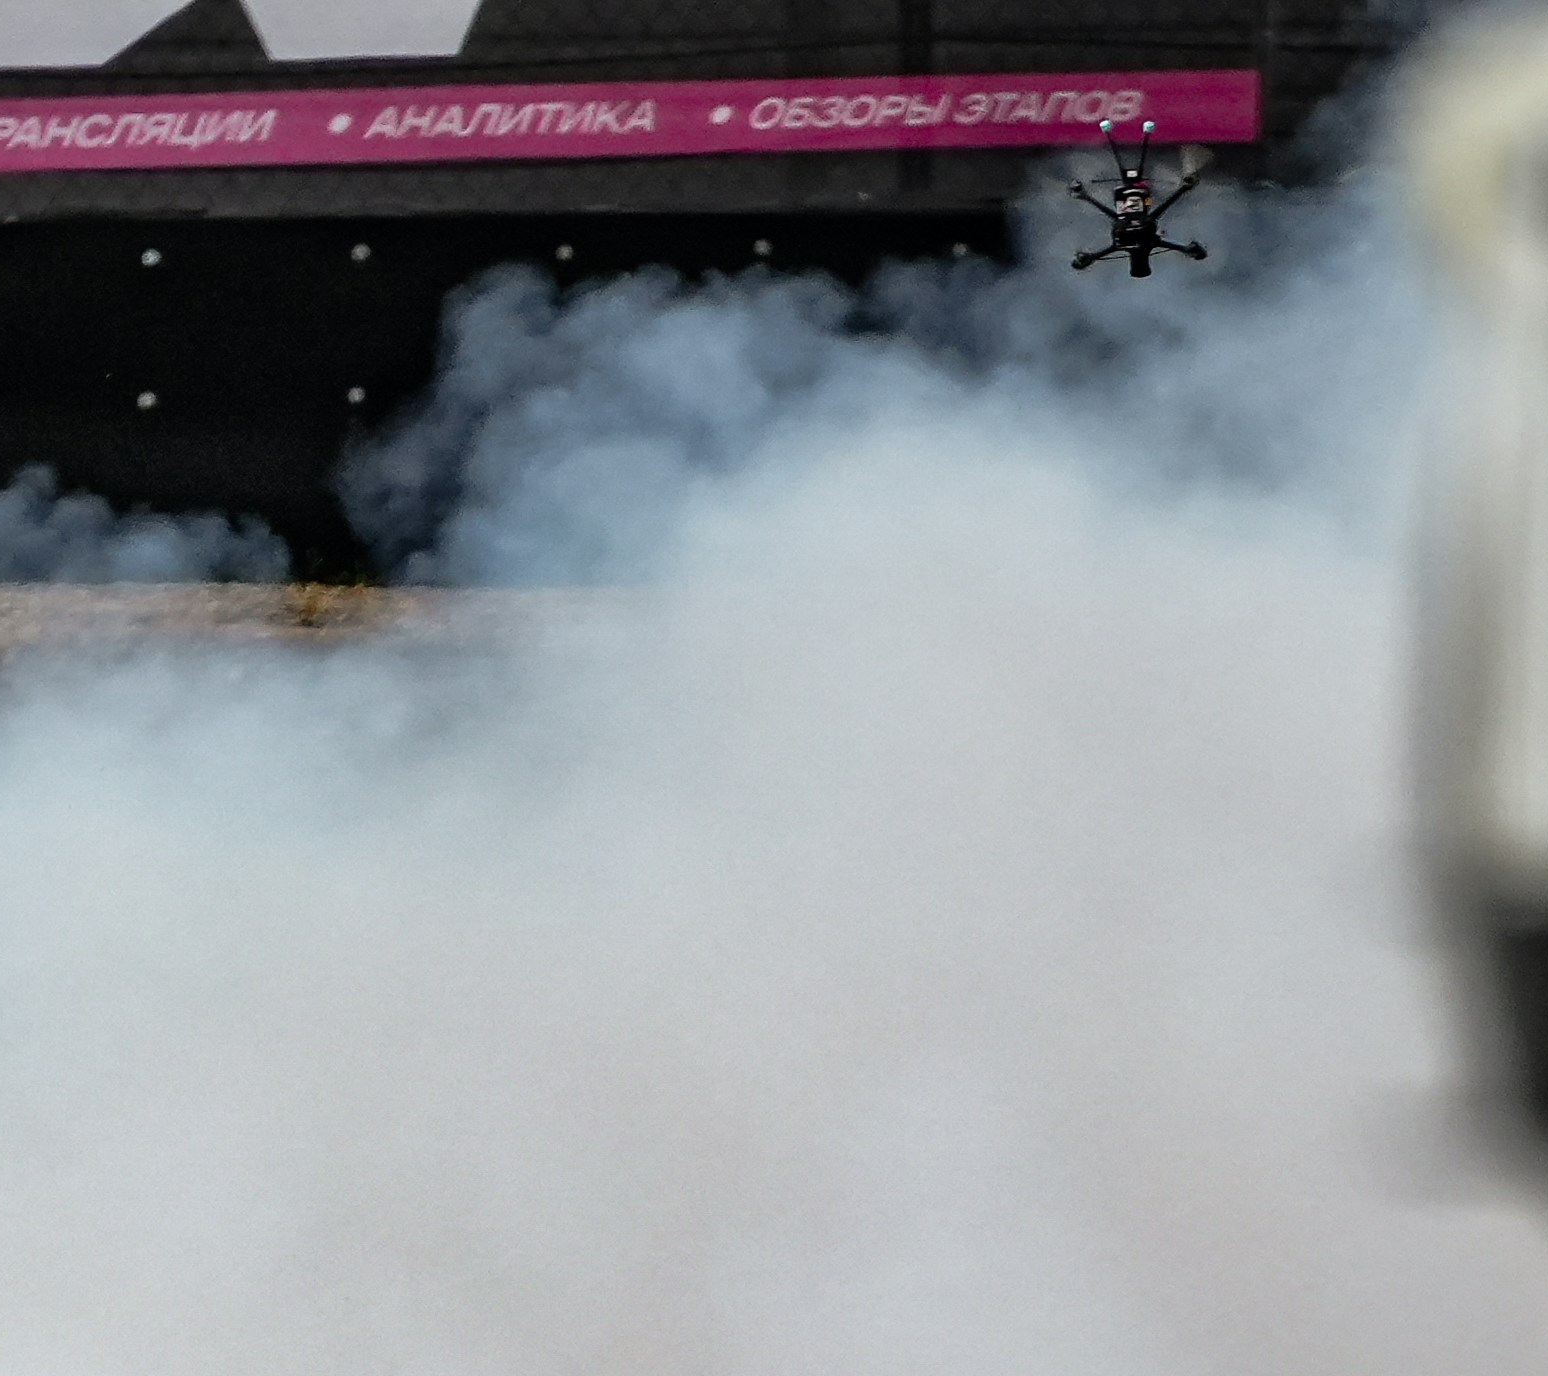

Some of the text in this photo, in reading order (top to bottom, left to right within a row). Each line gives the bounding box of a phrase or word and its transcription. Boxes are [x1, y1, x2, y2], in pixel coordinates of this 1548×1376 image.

[363, 98, 655, 140] АНАЛИТИКА
[748, 89, 1144, 131] ОБЗОРЫ ЭТАПОВ
